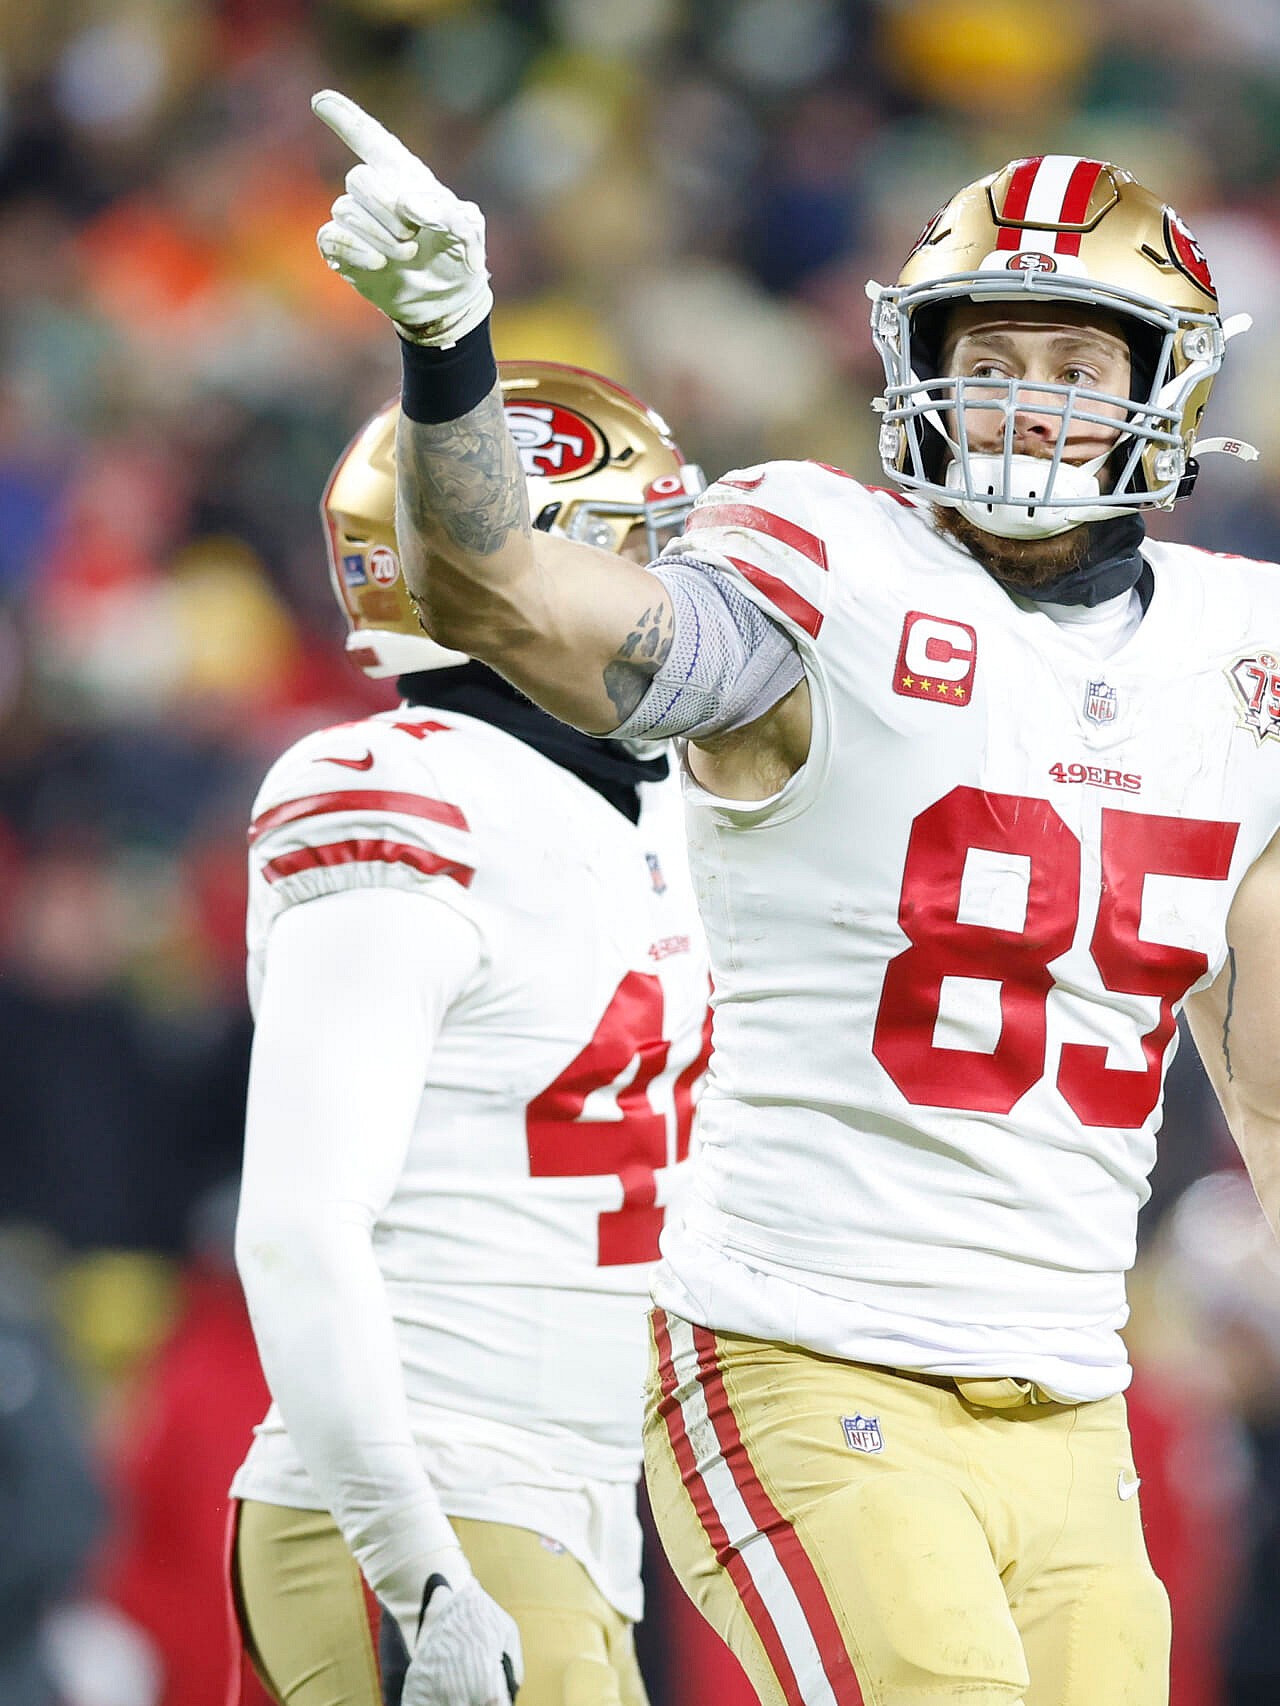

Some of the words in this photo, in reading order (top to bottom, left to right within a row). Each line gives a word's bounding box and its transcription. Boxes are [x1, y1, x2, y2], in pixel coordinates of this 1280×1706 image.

[1222, 441, 1242, 454] 85
[372, 554, 396, 579] 70
[905, 618, 973, 682] C
[1089, 697, 1113, 720] NFL
[1048, 762, 1142, 791] 49ERS
[872, 784, 1241, 1129] 85
[526, 969, 715, 1267] 4
[850, 1431, 879, 1449] NFL
